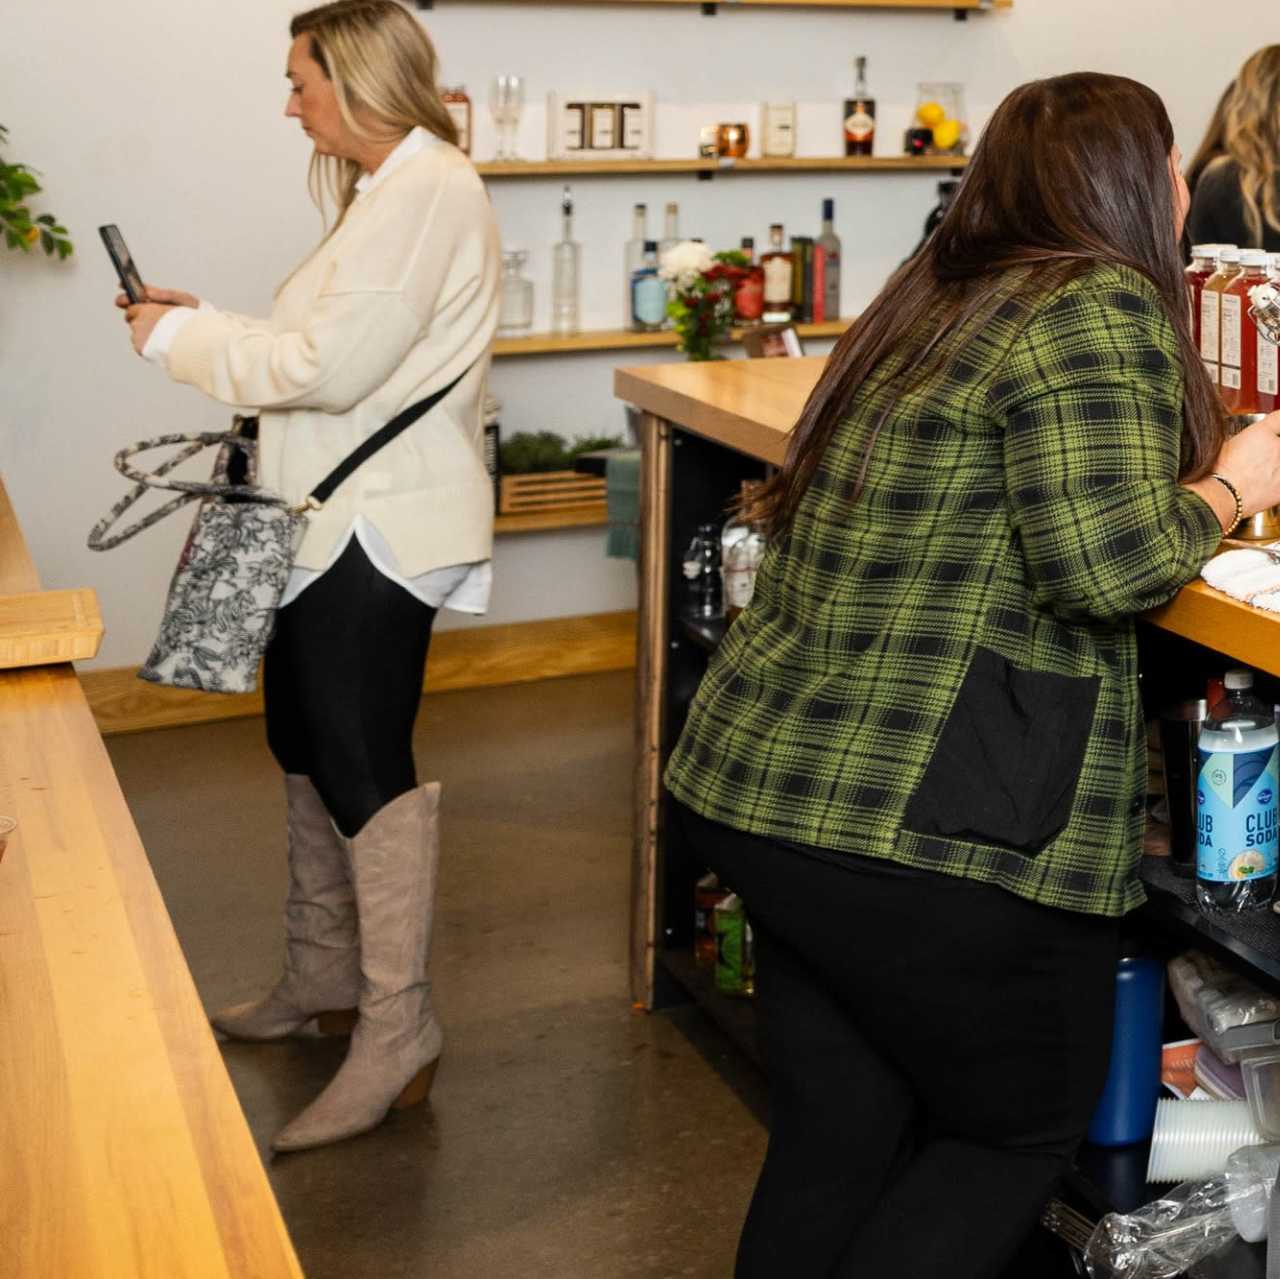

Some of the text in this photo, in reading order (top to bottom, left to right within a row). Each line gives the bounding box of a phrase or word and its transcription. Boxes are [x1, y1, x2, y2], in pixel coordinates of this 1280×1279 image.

[1198, 812, 1213, 833] UB
[1246, 807, 1279, 833] CLUB
[1199, 832, 1213, 847] DA
